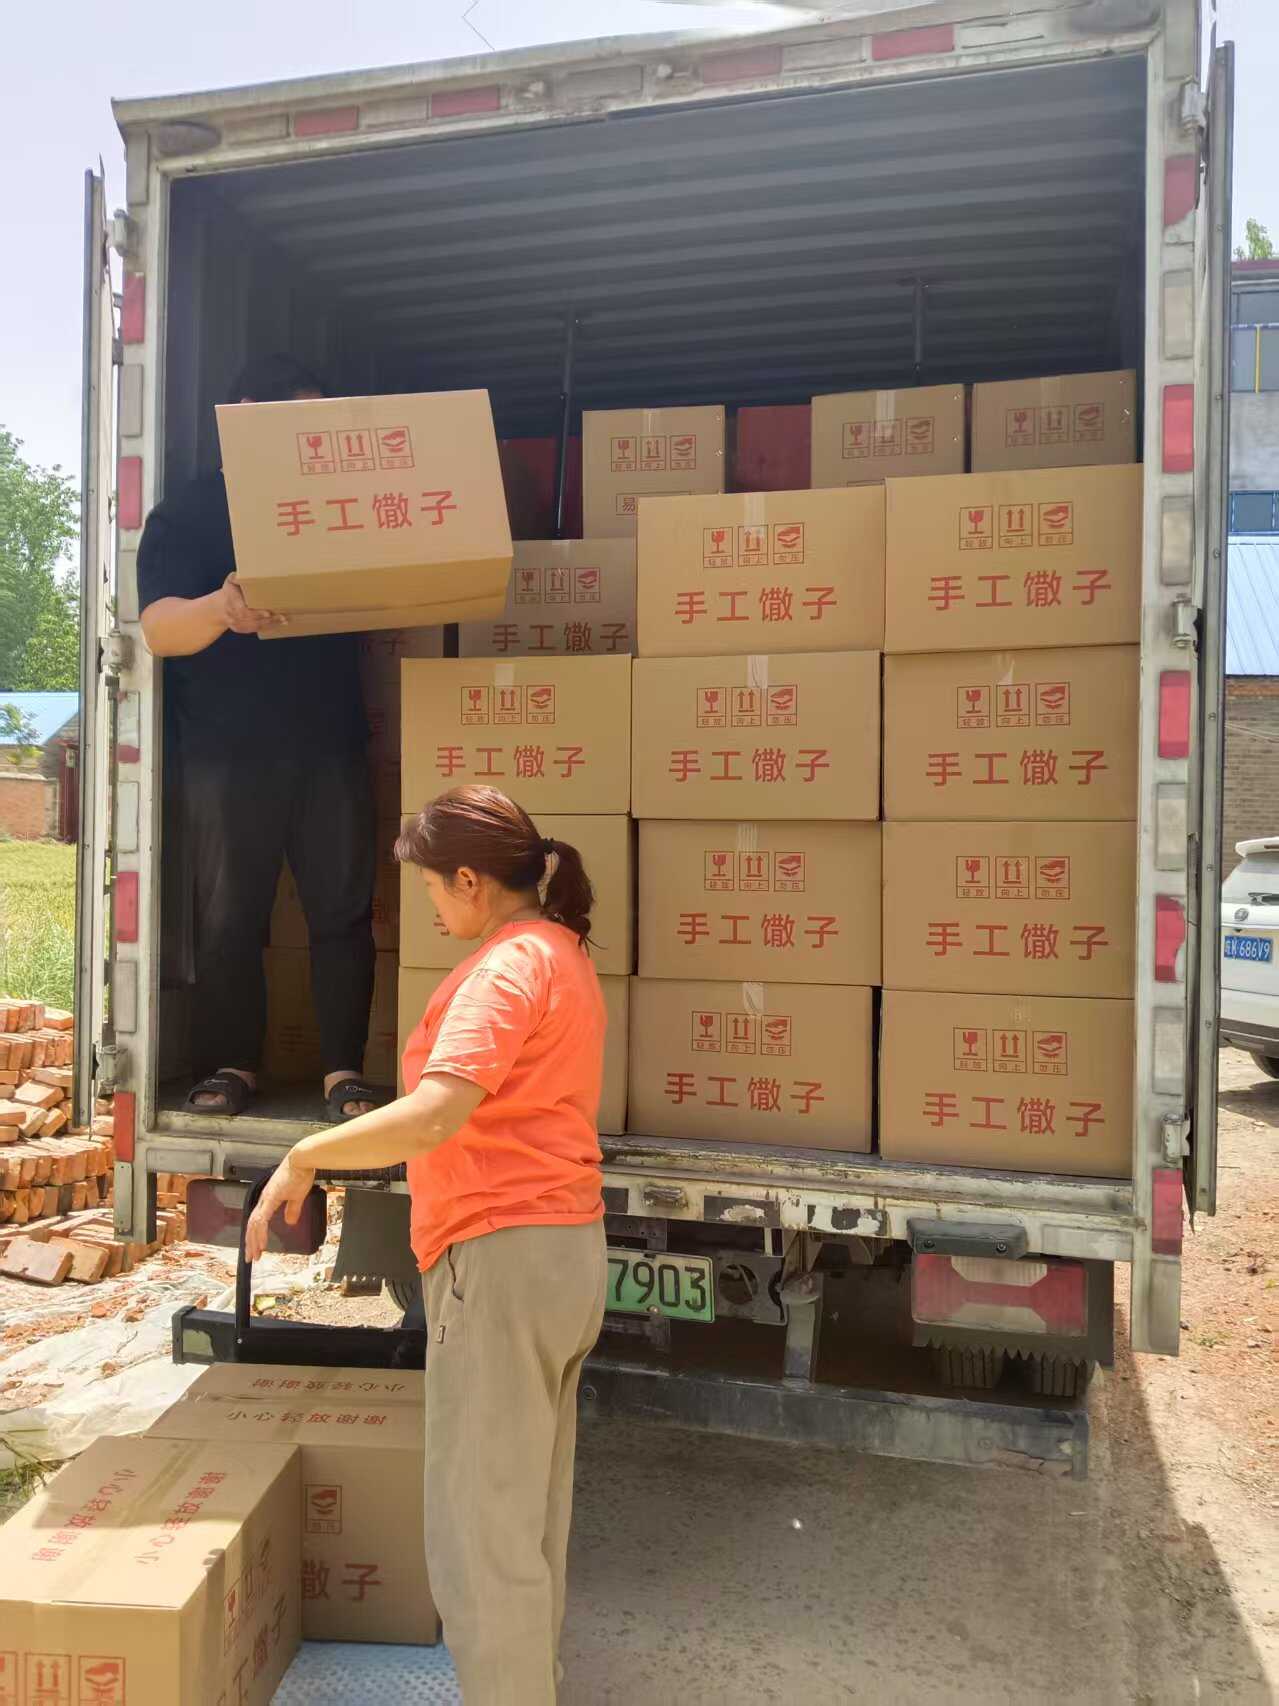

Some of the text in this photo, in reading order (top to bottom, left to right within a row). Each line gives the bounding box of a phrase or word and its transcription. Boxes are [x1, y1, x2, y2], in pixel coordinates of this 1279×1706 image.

[277, 491, 457, 536] 手工馓子
[675, 587, 837, 624] 手工馓子
[928, 570, 1111, 611] 手工馓子
[492, 622, 628, 654] 手工馓子
[436, 745, 585, 778] 手工馓子
[669, 748, 829, 783] 手工馓子
[926, 749, 1108, 786] 手工馓子
[677, 913, 838, 949] 手工馓子
[926, 923, 1108, 960] 手工馓子
[665, 1073, 824, 1114] 手工馓子
[923, 1093, 1105, 1137] 手工馓子
[608, 1258, 707, 1312] 7903
[227, 1410, 388, 1425] 小心轻放谢谢
